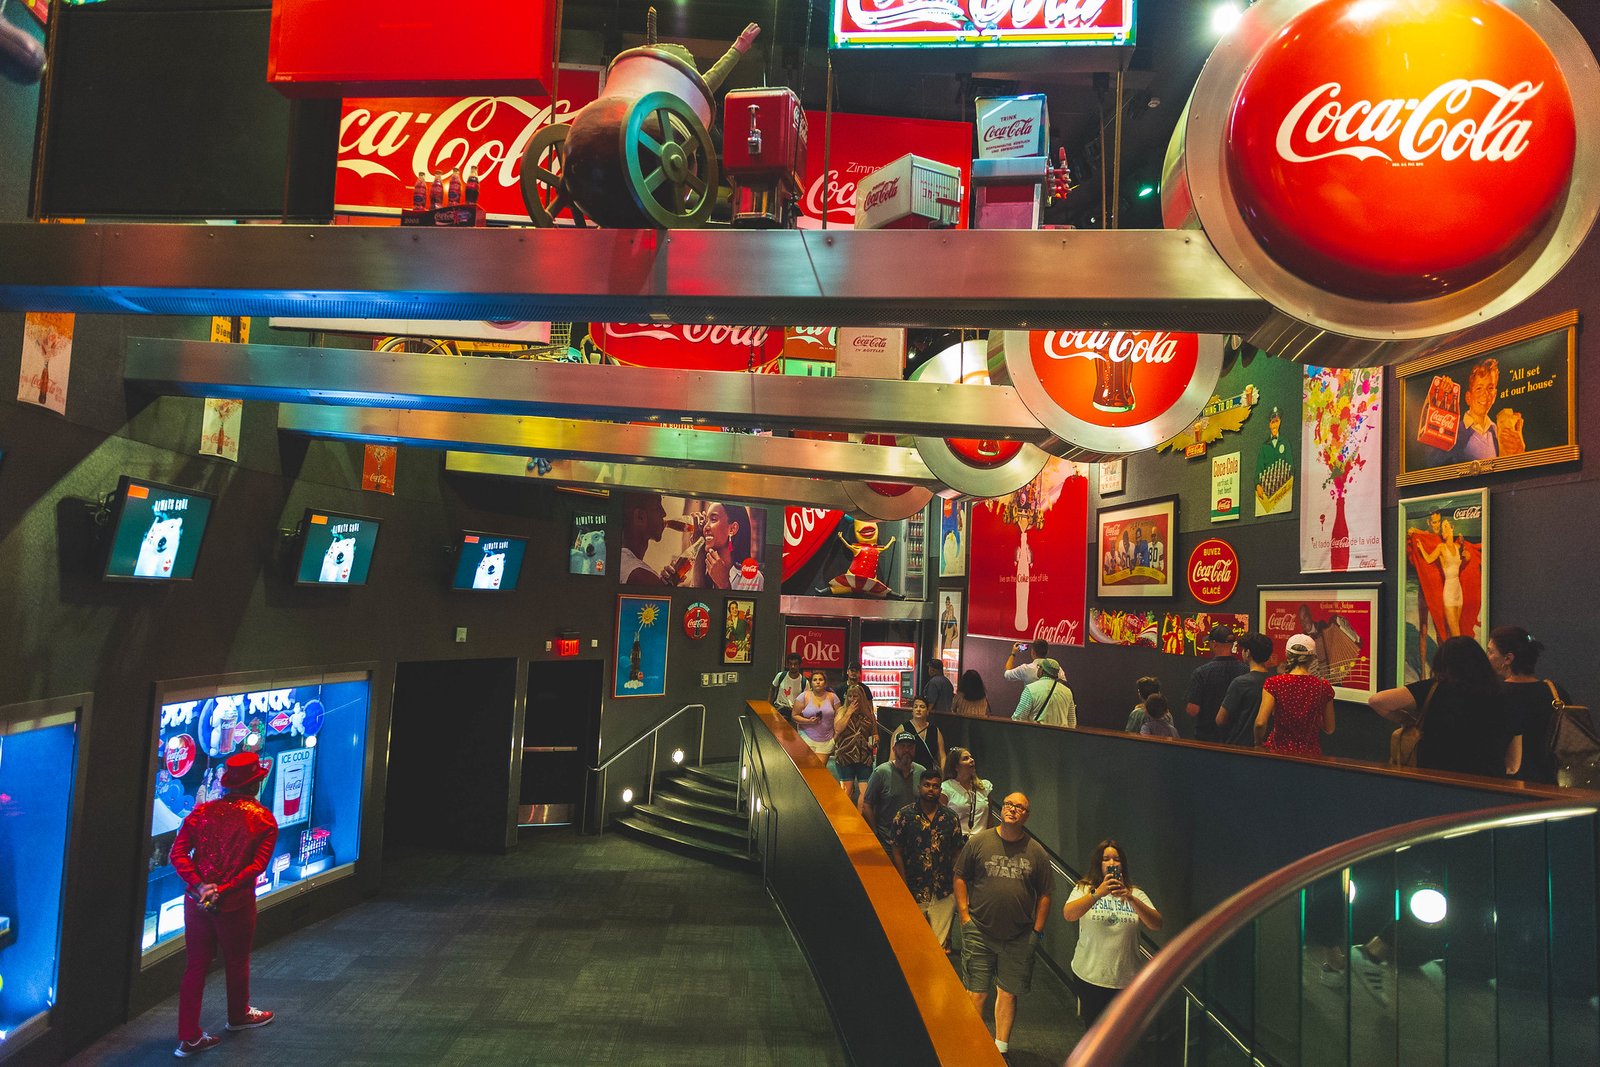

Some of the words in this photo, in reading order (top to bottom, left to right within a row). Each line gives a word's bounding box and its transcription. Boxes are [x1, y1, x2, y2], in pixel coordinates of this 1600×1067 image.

[1001, 114, 1017, 122] TRINK
[1276, 79, 1545, 163] Coca-Cola
[984, 117, 1035, 142] Coca-Cola
[864, 176, 900, 211] Coca-Cola
[853, 336, 888, 348] Coca-Cola
[1526, 365, 1540, 376] set
[1500, 388, 1509, 399] at
[1511, 386, 1525, 396] our
[1430, 410, 1456, 429] Coca-Cola
[1214, 458, 1238, 477] Coca-Cola
[1453, 506, 1481, 520] Coca-Cola
[1203, 547, 1221, 556] BUVEZ
[741, 565, 759, 573] Coca-Cola
[1193, 559, 1233, 583] Coca-Cola
[1017, 573, 1029, 583] Coke
[1202, 585, 1221, 595] GLACÉ
[1268, 613, 1296, 631] Coca-Cola
[808, 630, 822, 638] Enjoy
[791, 634, 840, 662] Coke
[281, 754, 291, 764] ICE
[292, 751, 309, 762] COLD
[985, 855, 1031, 869] STAR
[1115, 899, 1133, 912] ISLAN
